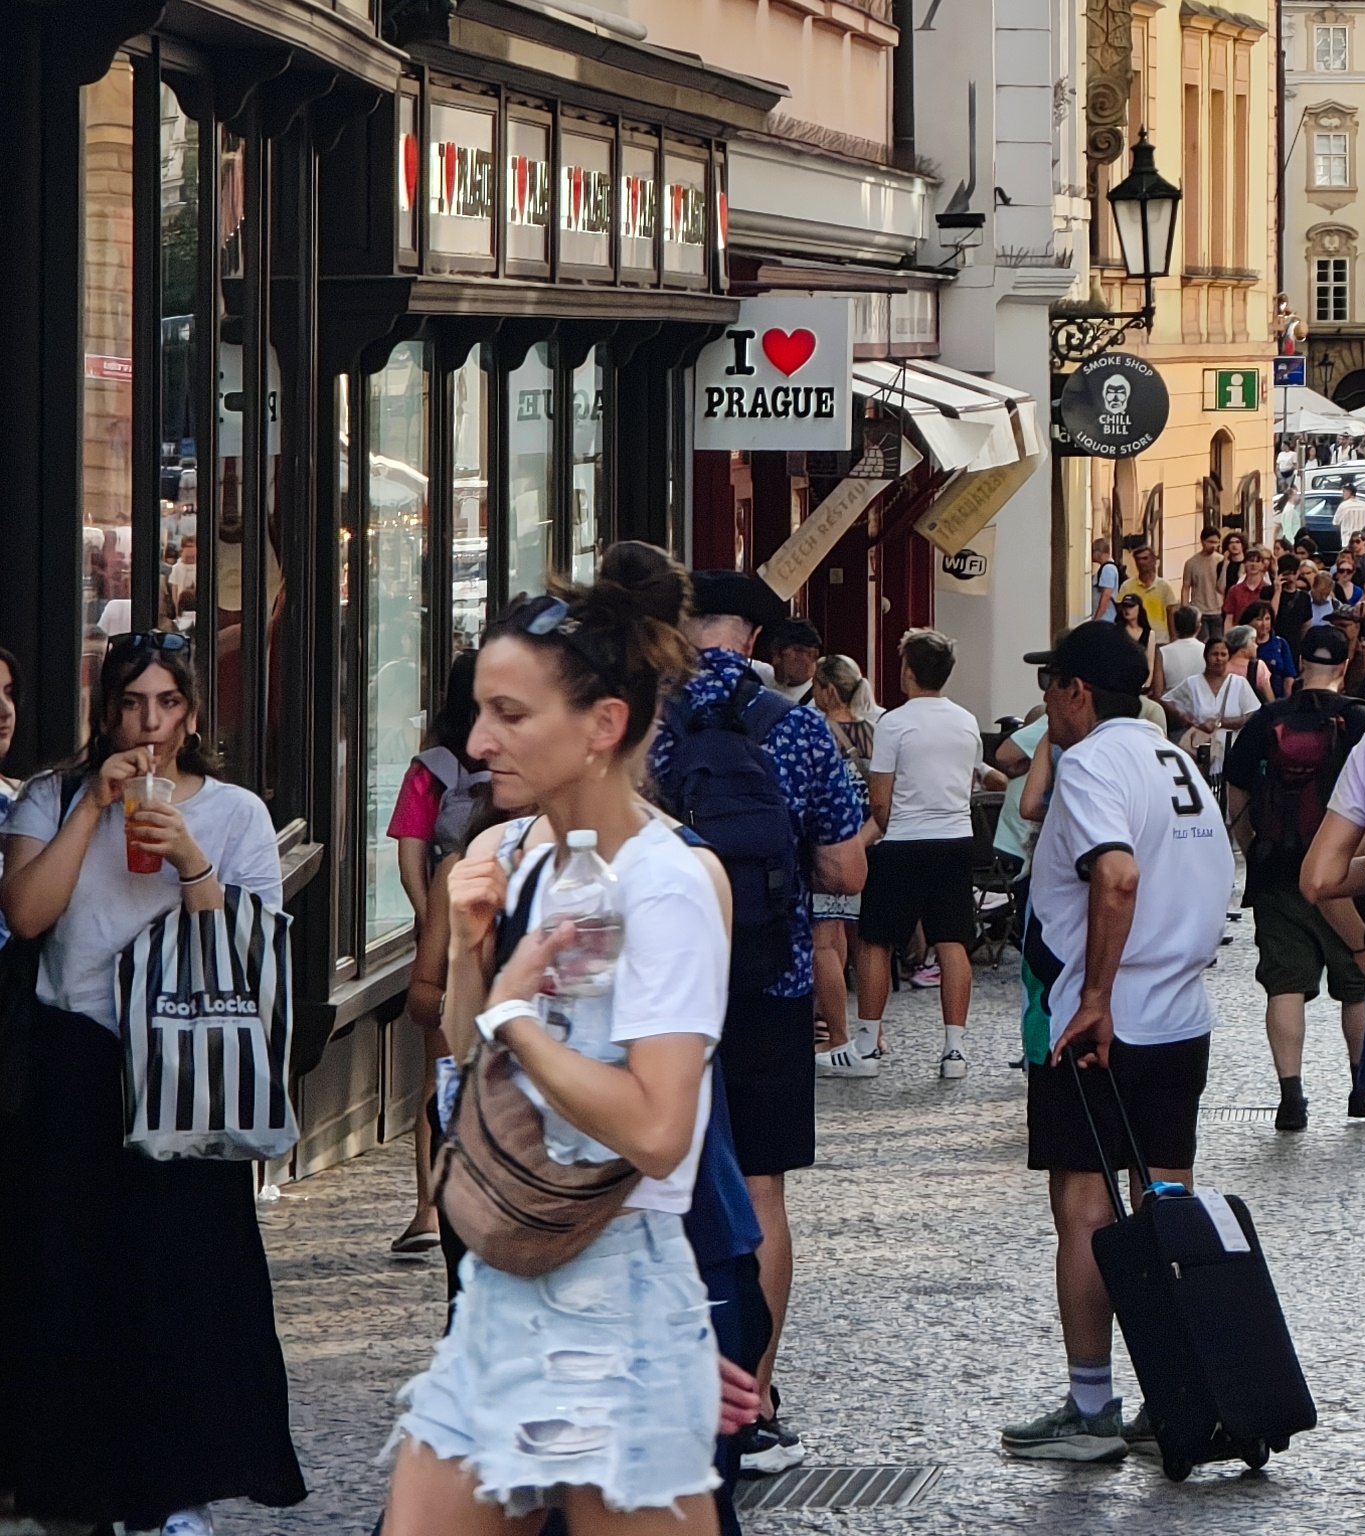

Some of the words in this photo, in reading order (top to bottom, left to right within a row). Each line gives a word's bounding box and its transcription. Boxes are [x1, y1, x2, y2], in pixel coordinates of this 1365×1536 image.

[725, 329, 756, 376] I
[1083, 356, 1121, 375] SMOKE
[1125, 357, 1154, 377] SHOP
[704, 386, 835, 419] PRAGUE
[1098, 414, 1132, 425] CHILL
[1103, 424, 1129, 435] BILL
[1076, 430, 1117, 455] LIQUOR
[1120, 432, 1154, 455] STORE
[777, 534, 819, 581] CZECH
[1155, 749, 1204, 818] 3
[203, 993, 258, 1014] Locke
